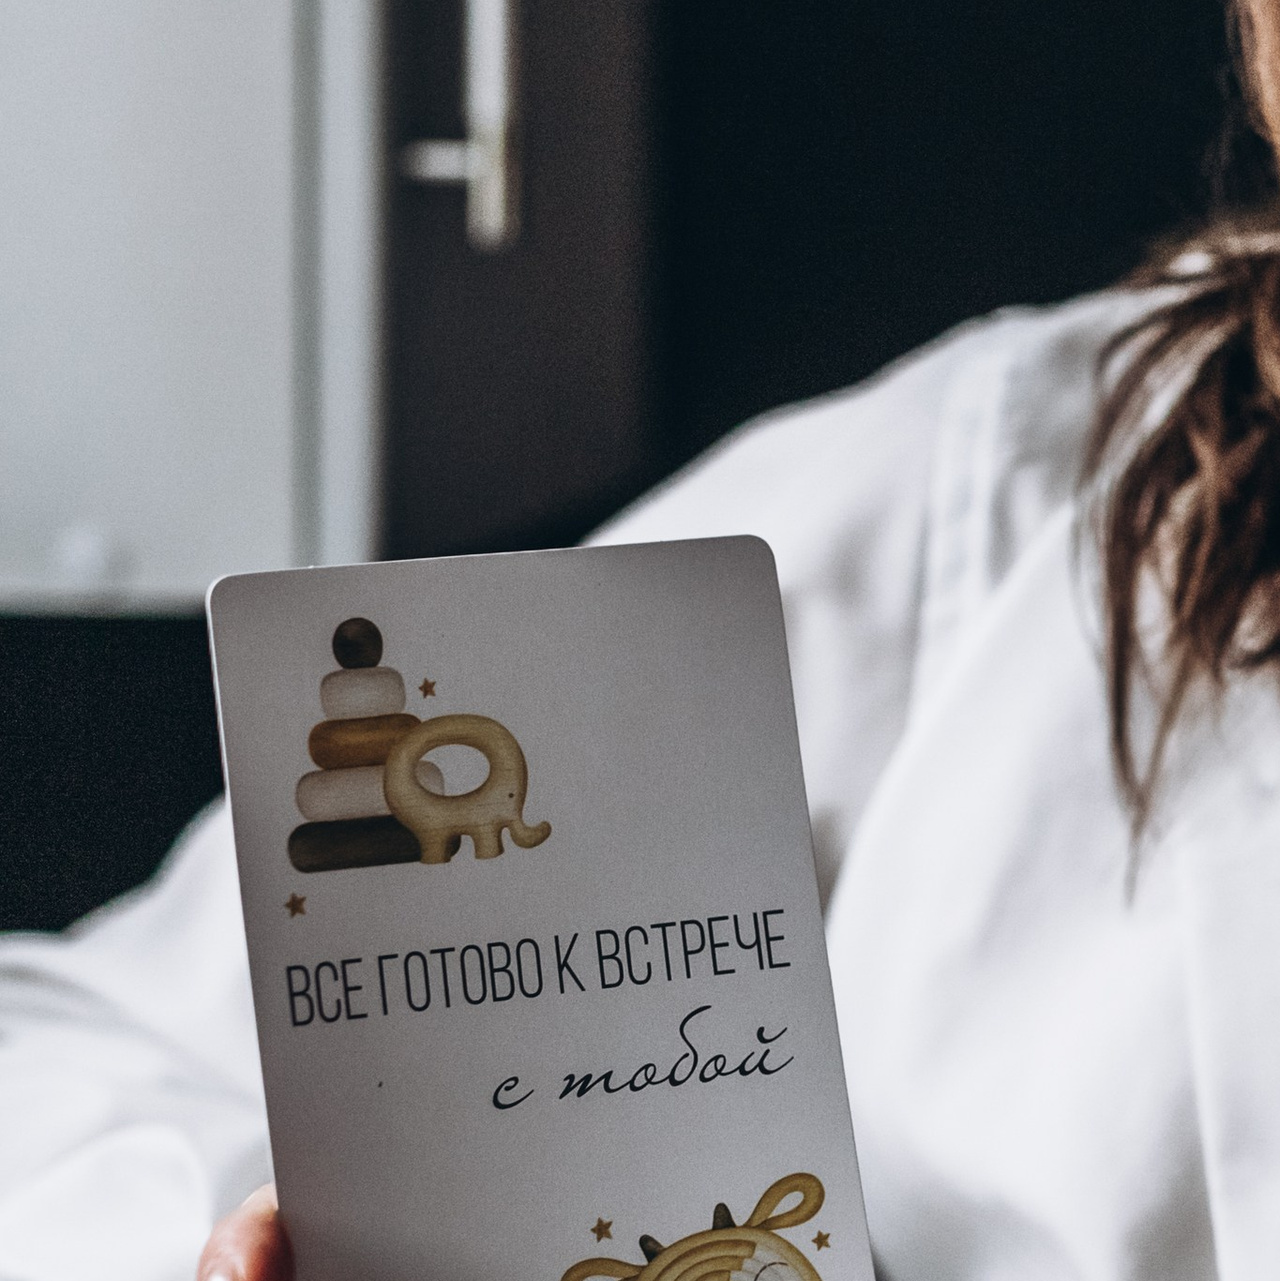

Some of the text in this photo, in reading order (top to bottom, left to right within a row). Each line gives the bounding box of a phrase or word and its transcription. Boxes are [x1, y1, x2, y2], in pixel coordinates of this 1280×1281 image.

[286, 908, 792, 1027] ВСЕ ГОТОВО К ВСТРЕЧЕ
[491, 1004, 795, 1111] с тобой
